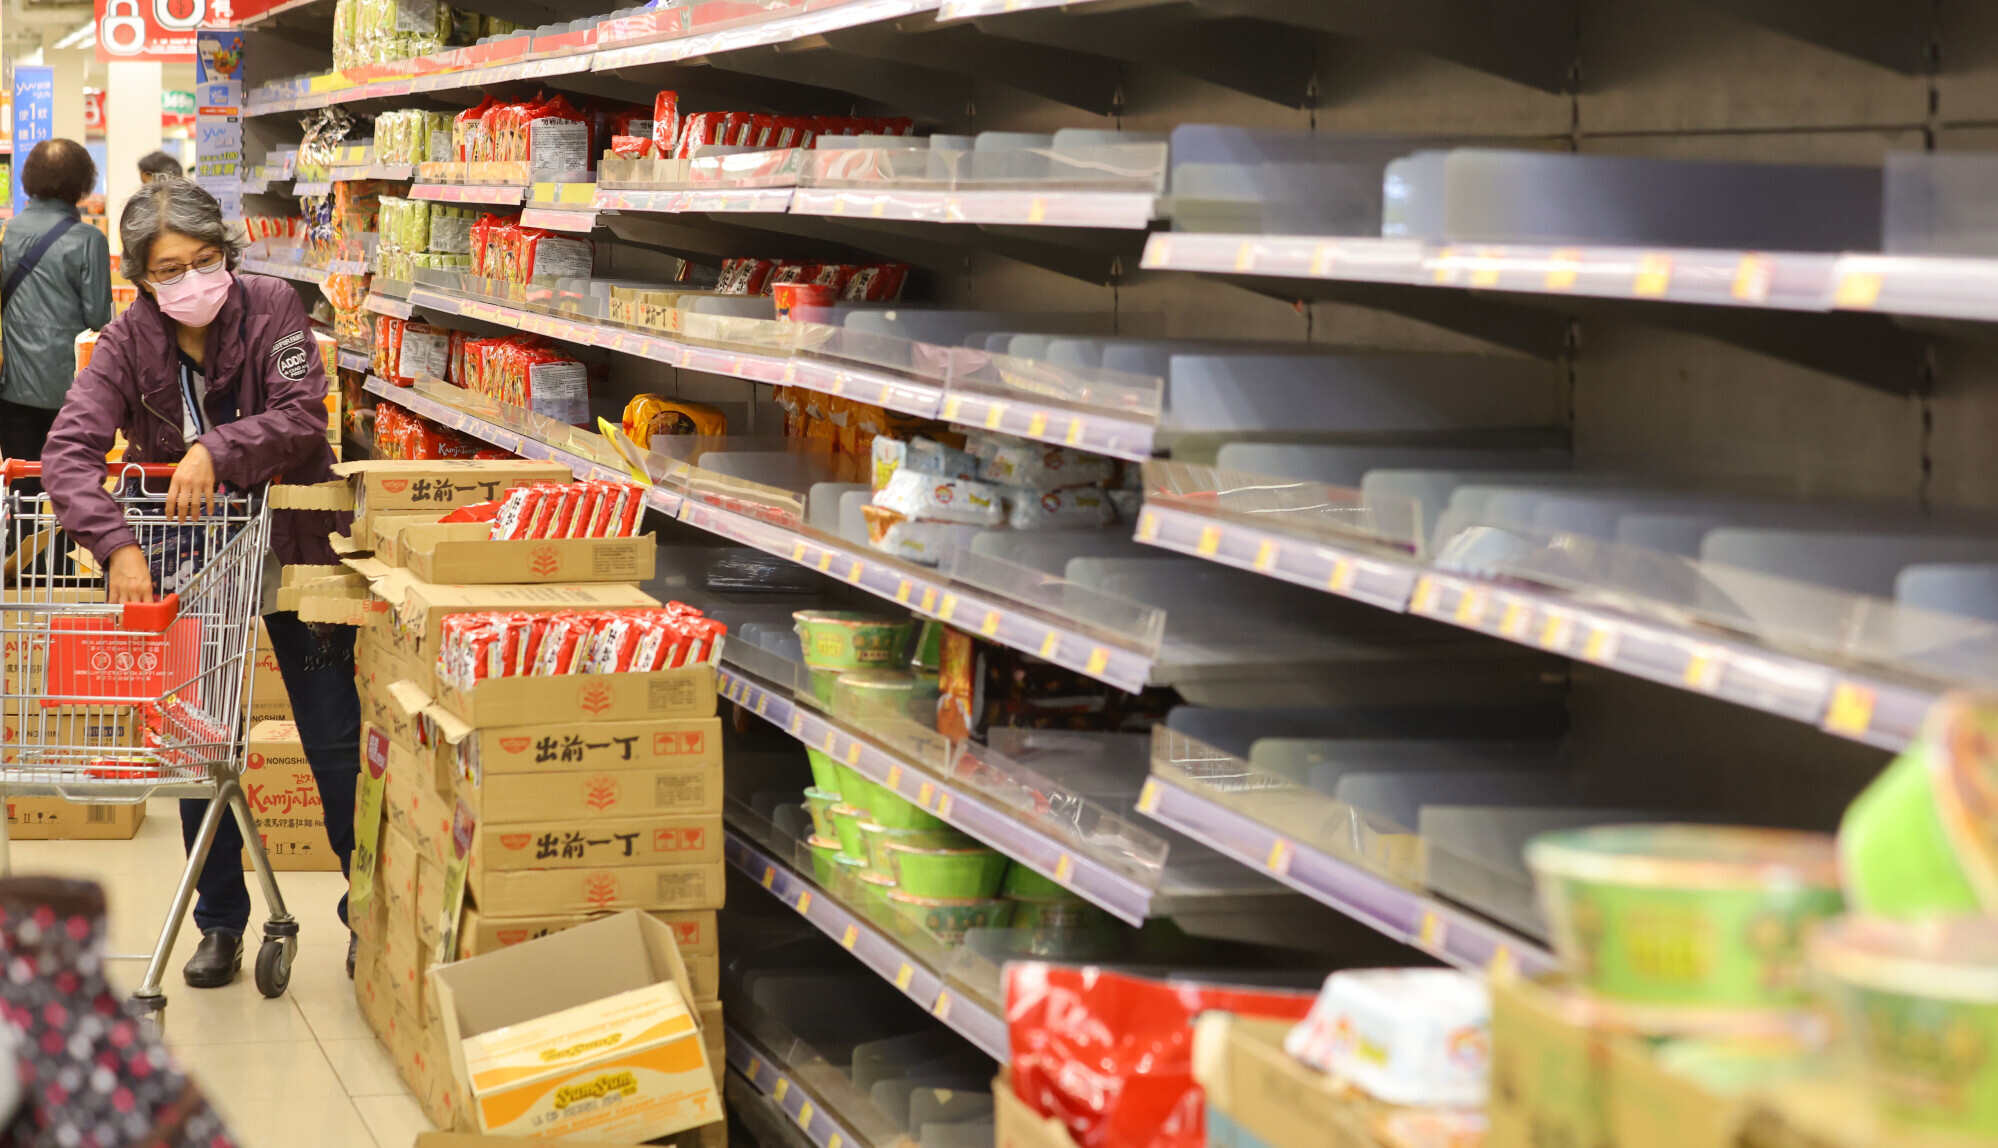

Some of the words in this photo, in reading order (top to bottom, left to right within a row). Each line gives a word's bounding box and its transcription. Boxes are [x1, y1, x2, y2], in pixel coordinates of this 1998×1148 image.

[411, 478, 501, 502] 出前一丁
[535, 735, 639, 763] 出前一丁
[536, 832, 640, 859] 出前一丁
